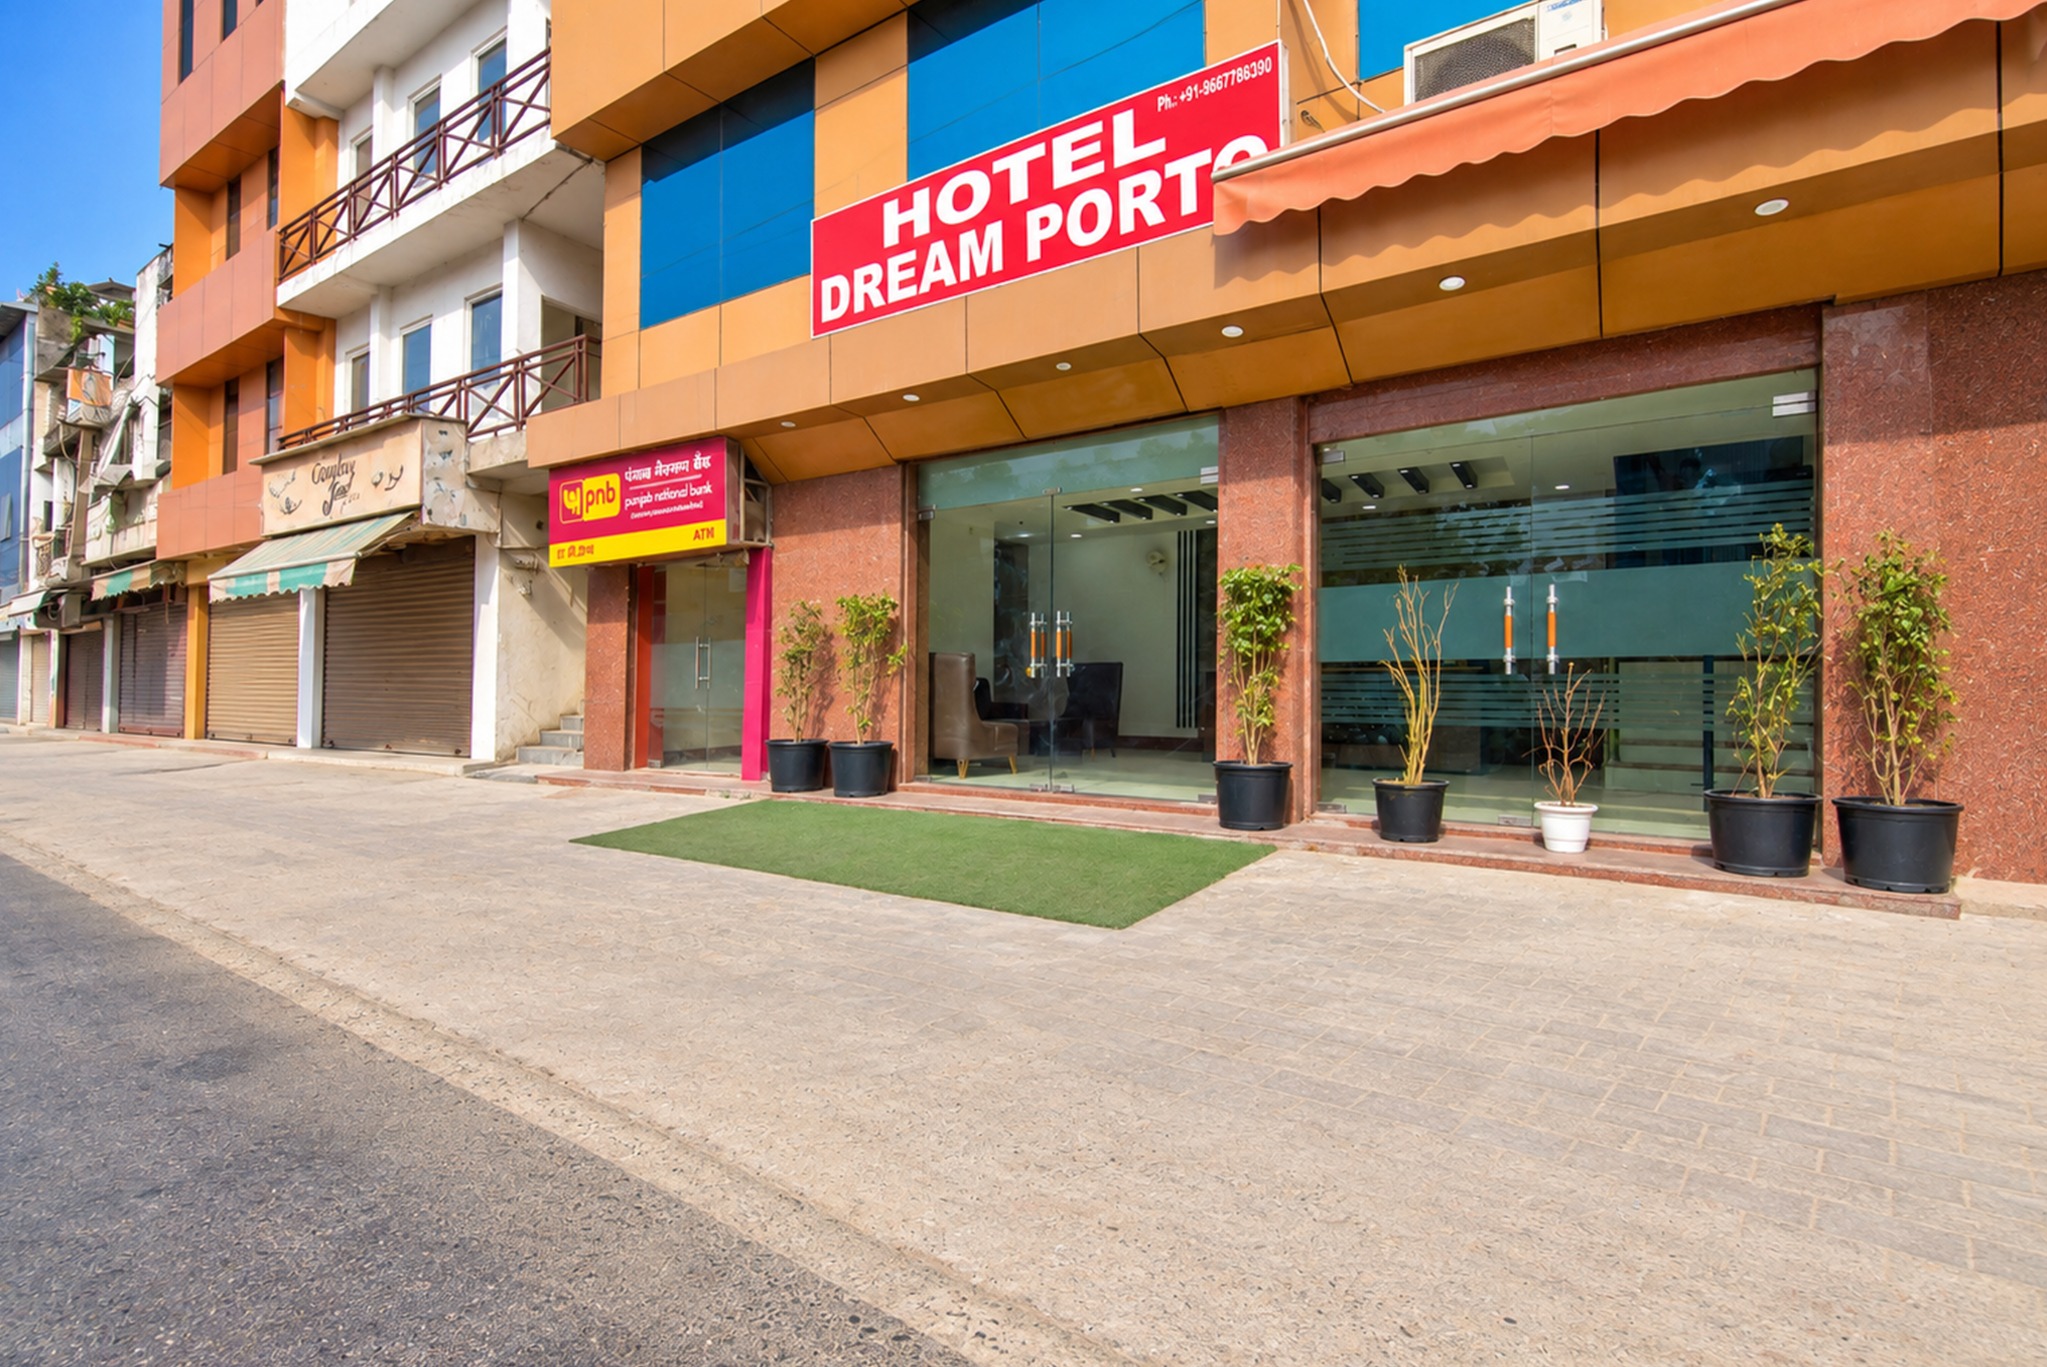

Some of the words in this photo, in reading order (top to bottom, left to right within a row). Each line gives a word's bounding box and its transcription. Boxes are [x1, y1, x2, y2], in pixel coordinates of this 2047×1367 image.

[883, 108, 1166, 248] HOTEL
[820, 219, 1004, 323] DREAM
[585, 481, 616, 514] pnb
[624, 491, 653, 511] punjab
[654, 483, 689, 502] national
[689, 480, 713, 496] bank
[693, 526, 715, 541] ATM
